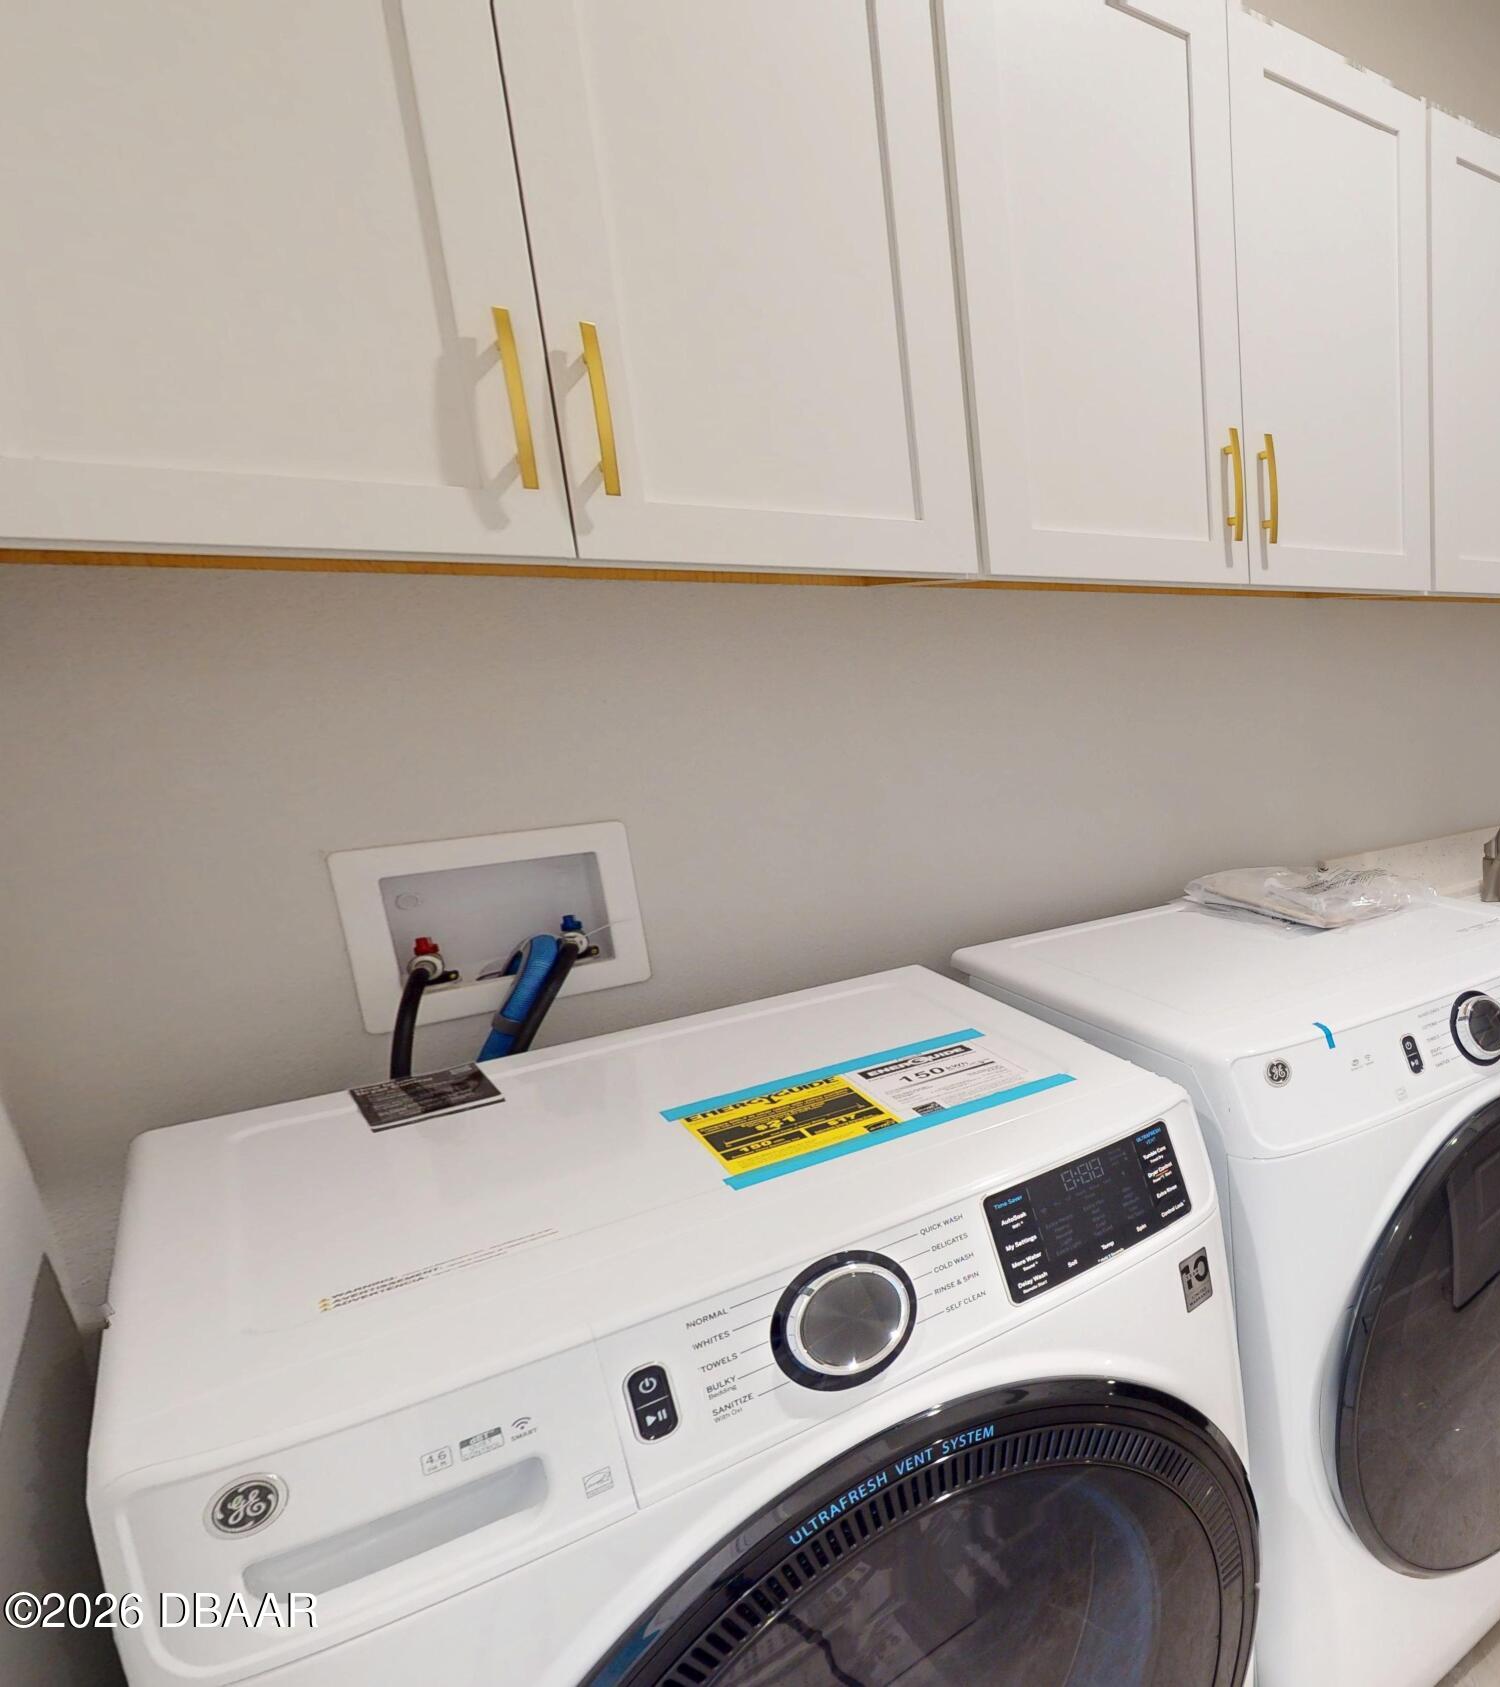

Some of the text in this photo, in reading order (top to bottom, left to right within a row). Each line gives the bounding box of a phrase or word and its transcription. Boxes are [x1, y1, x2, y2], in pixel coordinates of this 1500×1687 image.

[899, 1067, 945, 1082] 150
[920, 1213, 963, 1236] QUICK WASH
[931, 1232, 968, 1252] DELICATES
[1005, 1244, 1015, 1252] My
[933, 1252, 974, 1273] COLD WASH
[934, 1282, 955, 1295] RINSE
[963, 1271, 980, 1283] SPIN
[945, 1290, 987, 1313] SELF CLEAN
[685, 1308, 728, 1330] NORMAL
[692, 1330, 730, 1350] WHITES
[700, 1352, 738, 1374] TOWELS
[706, 1375, 737, 1394] BULKY
[708, 1385, 737, 1401] Bedding
[712, 1393, 754, 1417] SANITIZE
[714, 1412, 730, 1424] With
[789, 1425, 995, 1545] ULTRAFRESH VENT SYSTEM
